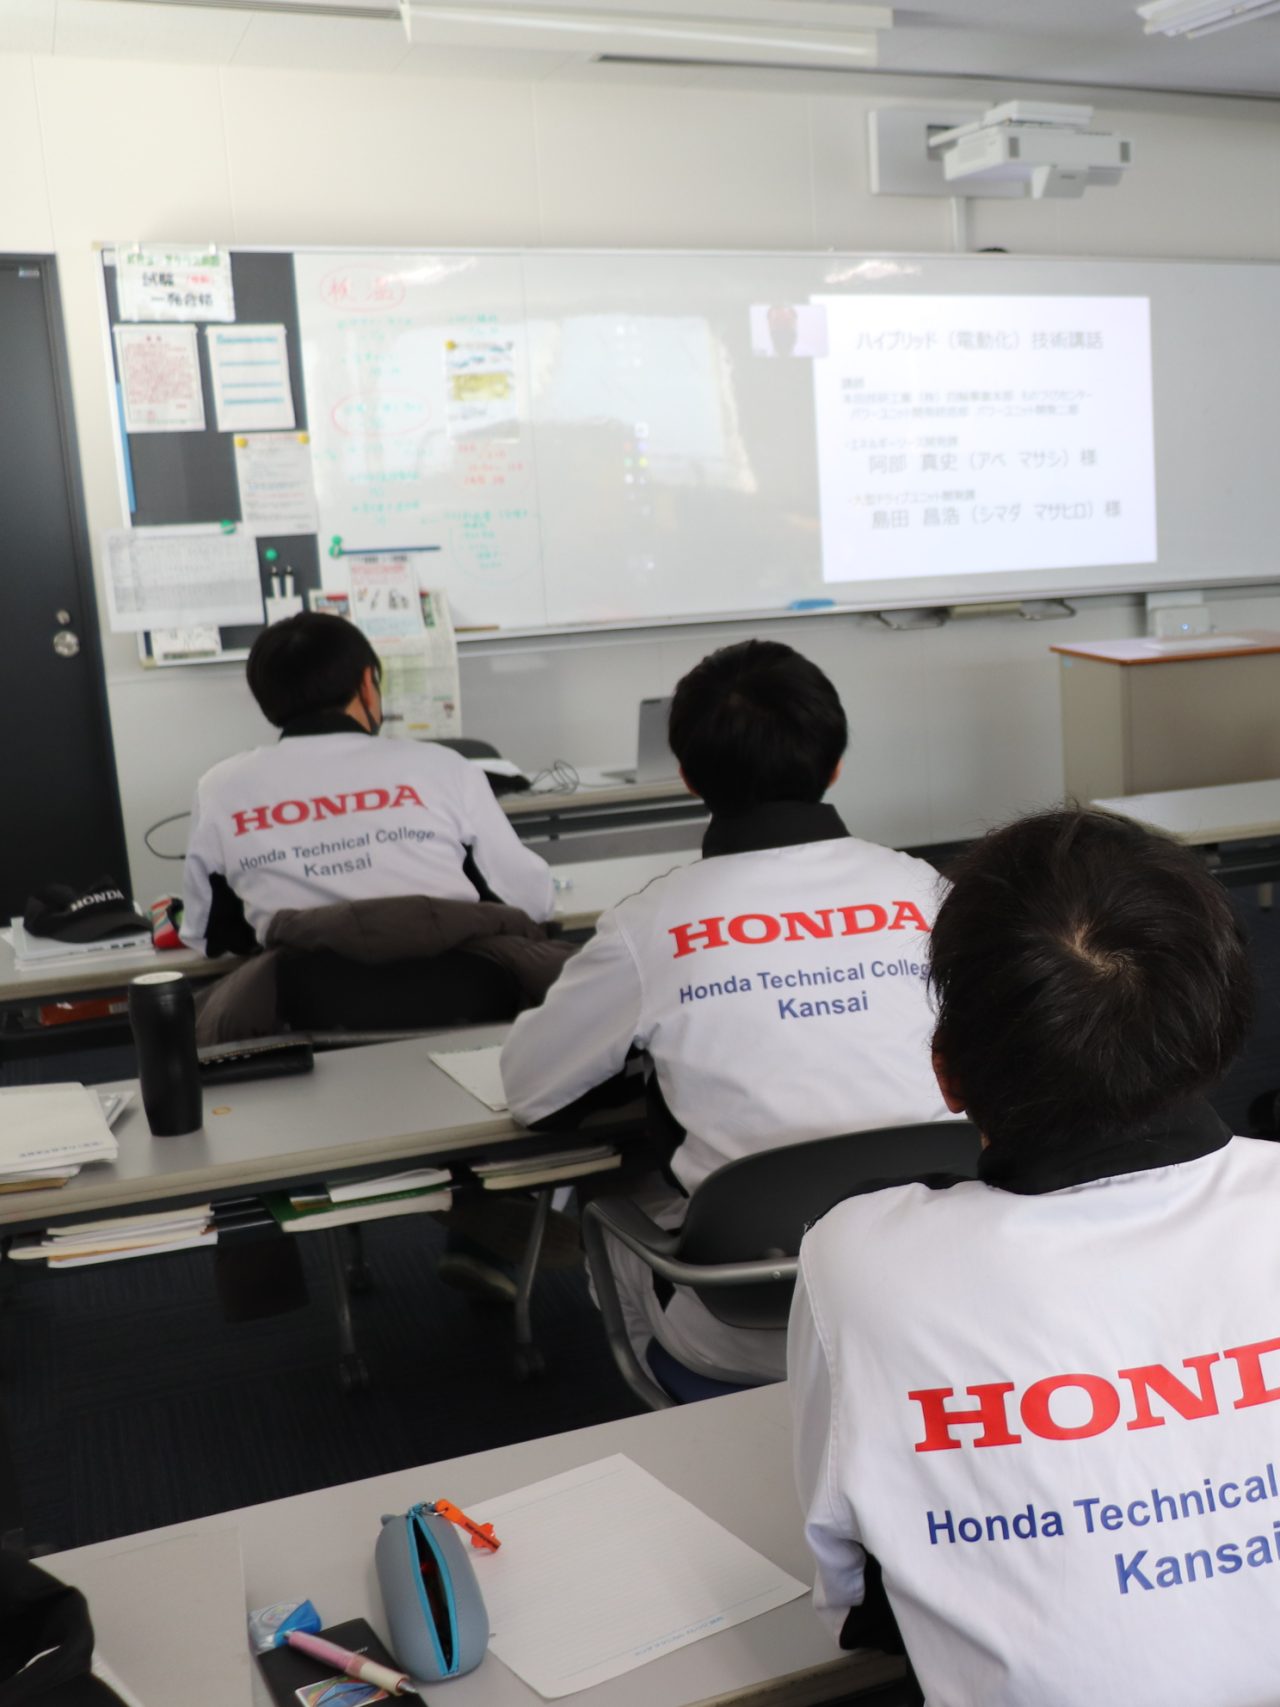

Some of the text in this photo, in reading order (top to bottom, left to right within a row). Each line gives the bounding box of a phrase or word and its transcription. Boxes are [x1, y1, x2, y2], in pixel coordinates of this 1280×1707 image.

[231, 785, 429, 838] HONDA
[239, 826, 435, 871] Honda Technical College
[304, 852, 373, 878] Kansai
[70, 889, 124, 912] HONDA
[668, 900, 933, 959] HONDA
[679, 958, 930, 1004] Honda Technical Colleg
[778, 990, 869, 1020] Kansai
[926, 1504, 1065, 1546] Honda
[1072, 1463, 1280, 1535] Technical
